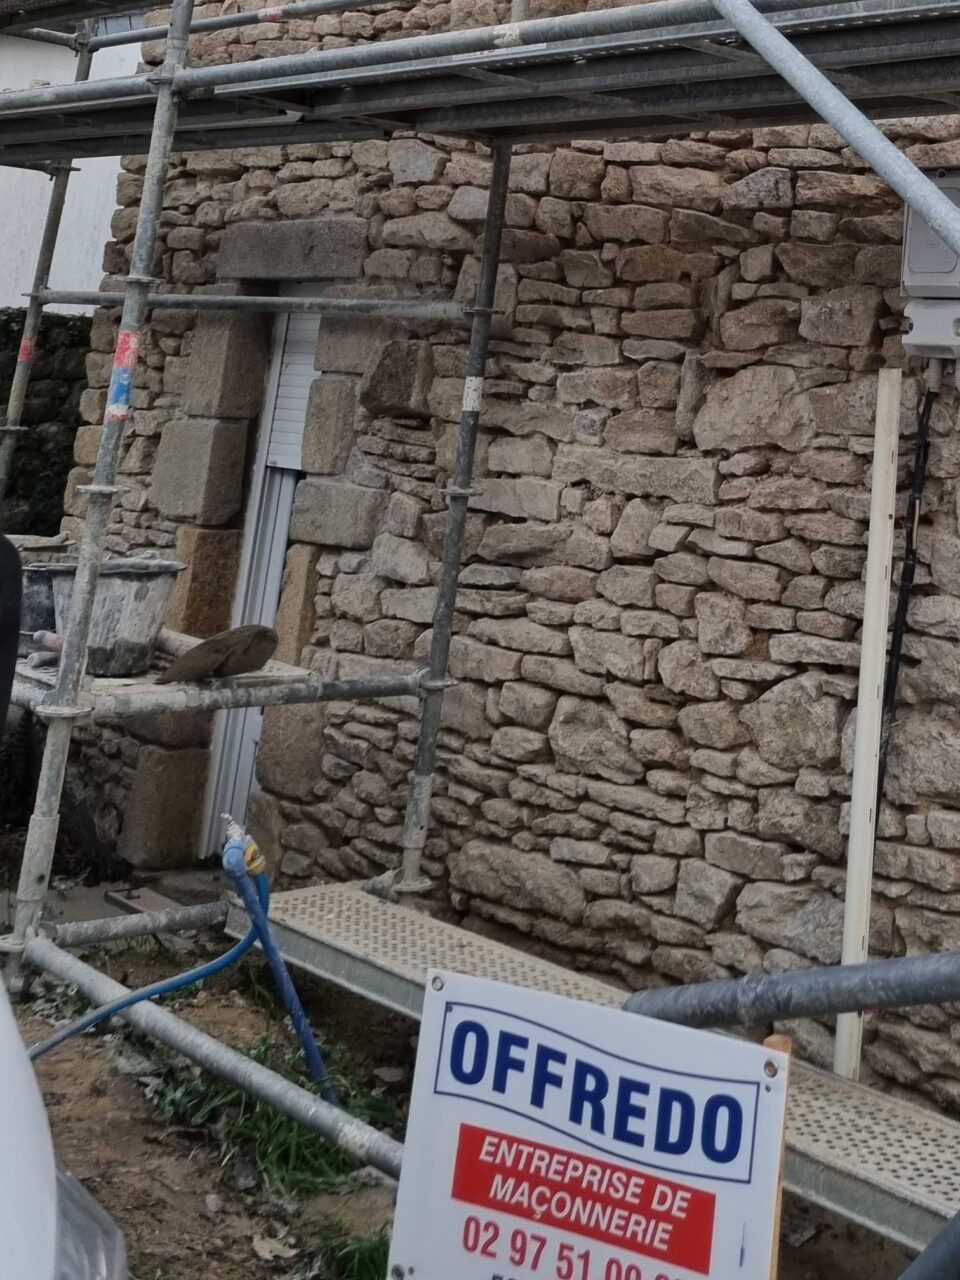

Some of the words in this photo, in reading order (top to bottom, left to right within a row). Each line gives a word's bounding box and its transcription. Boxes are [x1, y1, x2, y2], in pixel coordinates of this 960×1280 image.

[449, 1020, 743, 1163] OFFREDO
[479, 1135, 645, 1203] ENTREPRISE
[651, 1185, 692, 1218] DE
[489, 1174, 673, 1251] MAÇONNERIE
[462, 1215, 500, 1259] 02
[509, 1228, 548, 1272] 97
[556, 1242, 591, 1280] 51
